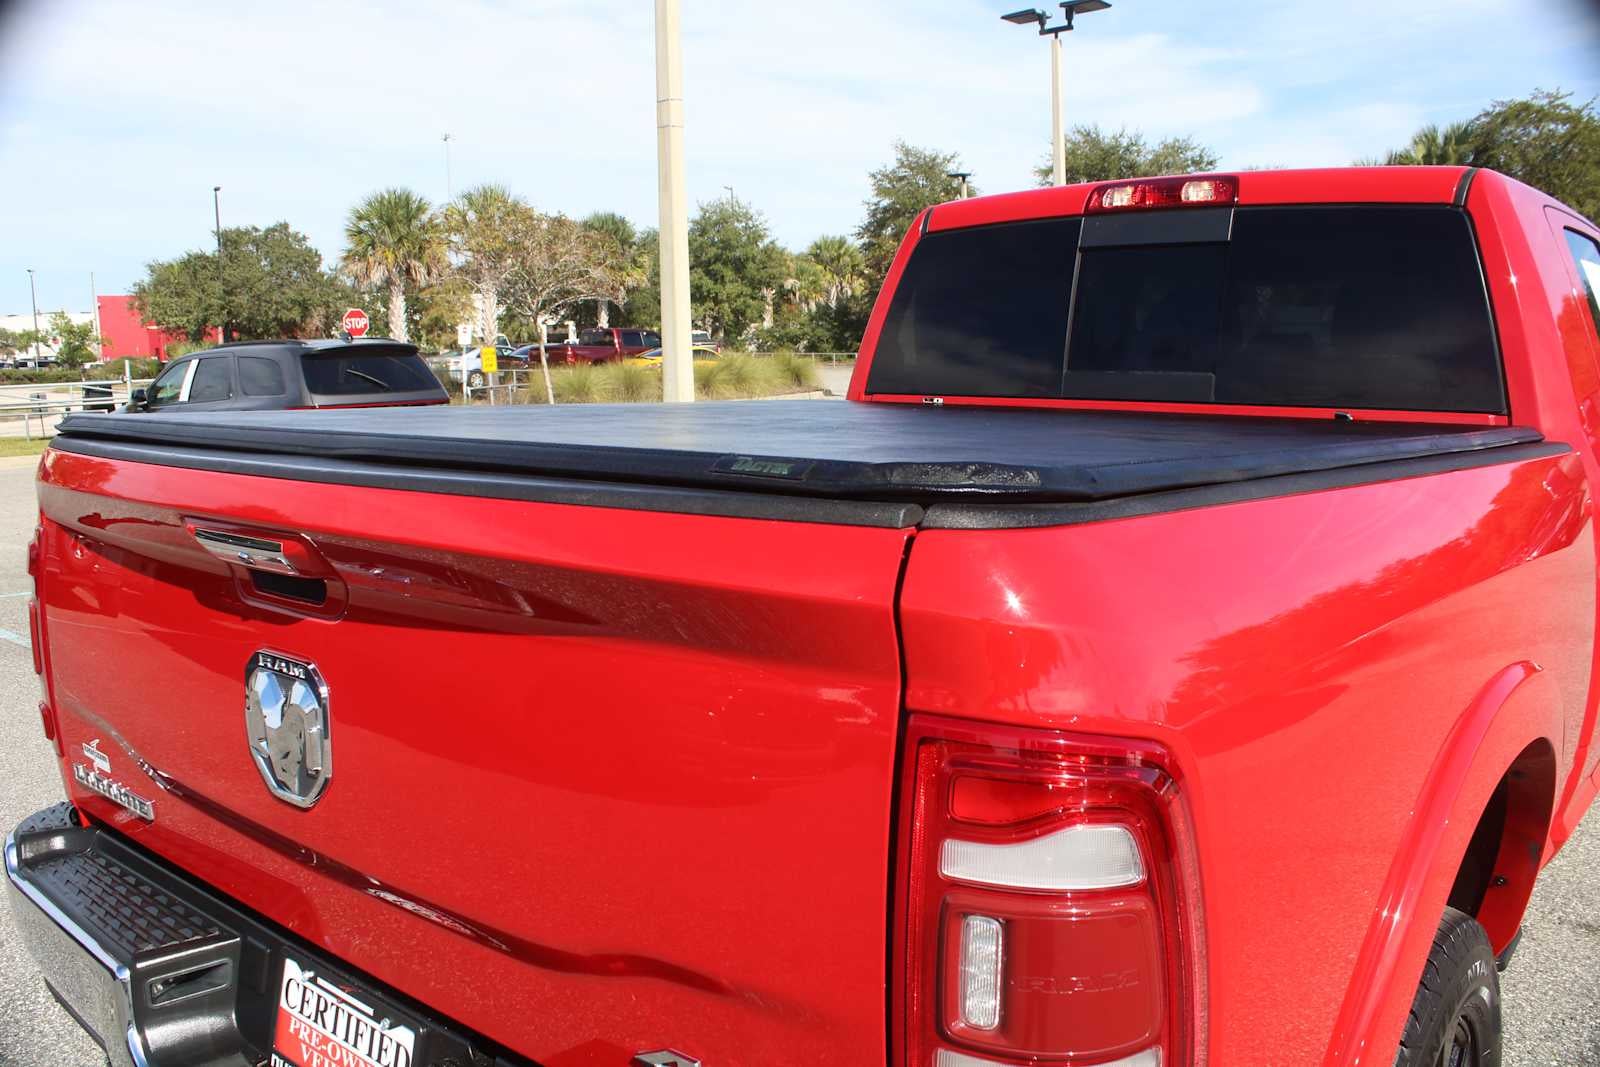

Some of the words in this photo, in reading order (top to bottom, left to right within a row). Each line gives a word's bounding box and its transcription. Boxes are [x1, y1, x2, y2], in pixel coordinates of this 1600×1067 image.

[345, 317, 367, 329] STOP
[258, 653, 306, 679] RAM
[285, 978, 411, 1067] CERTIFIED
